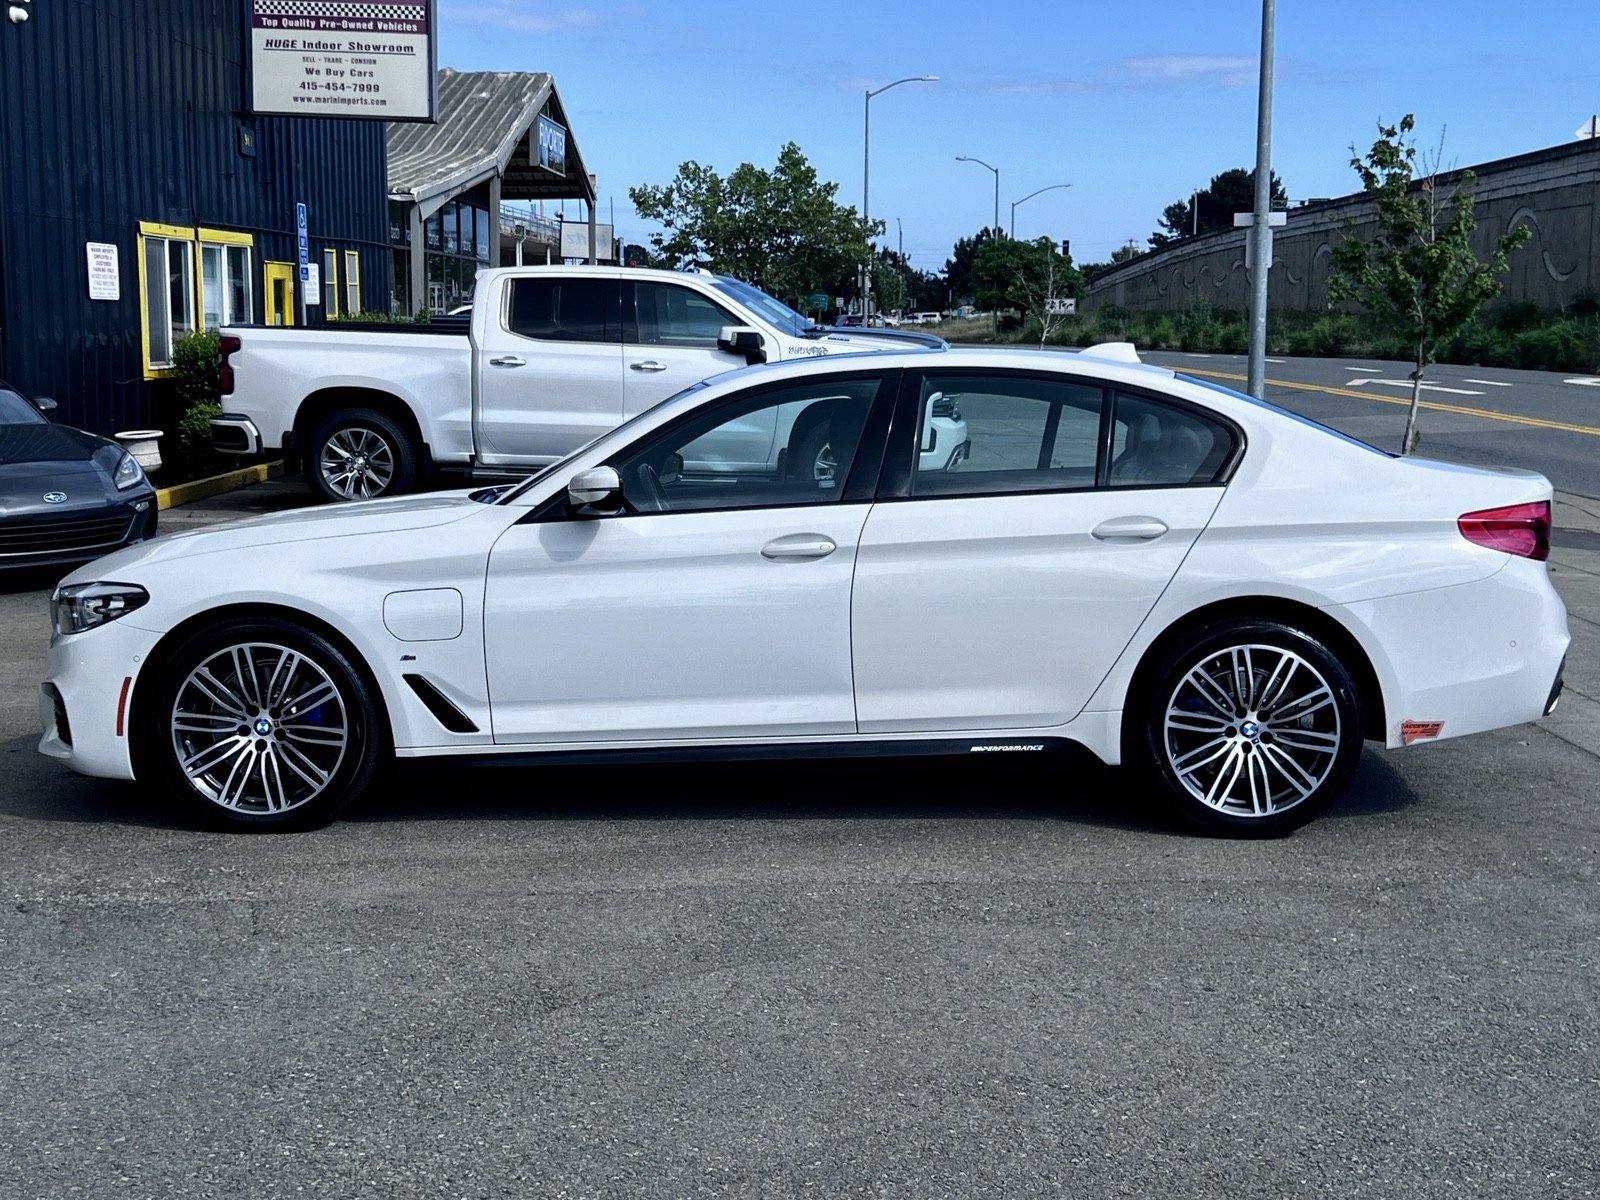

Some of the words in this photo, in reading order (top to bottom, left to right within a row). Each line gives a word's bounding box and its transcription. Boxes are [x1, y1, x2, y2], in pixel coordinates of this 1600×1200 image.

[261, 17, 279, 28] Top
[282, 17, 316, 29] Quality
[319, 19, 374, 30] Pre-Owned
[376, 21, 418, 32] Vehicles
[265, 39, 298, 49] HUGE
[302, 40, 342, 50] Indoor
[348, 41, 414, 53] Showroom
[305, 67, 321, 76] We
[325, 68, 345, 78] Buy
[350, 69, 374, 78] Cars
[299, 81, 380, 93] 415-454-7999
[292, 96, 387, 106] www.marinimports.com
